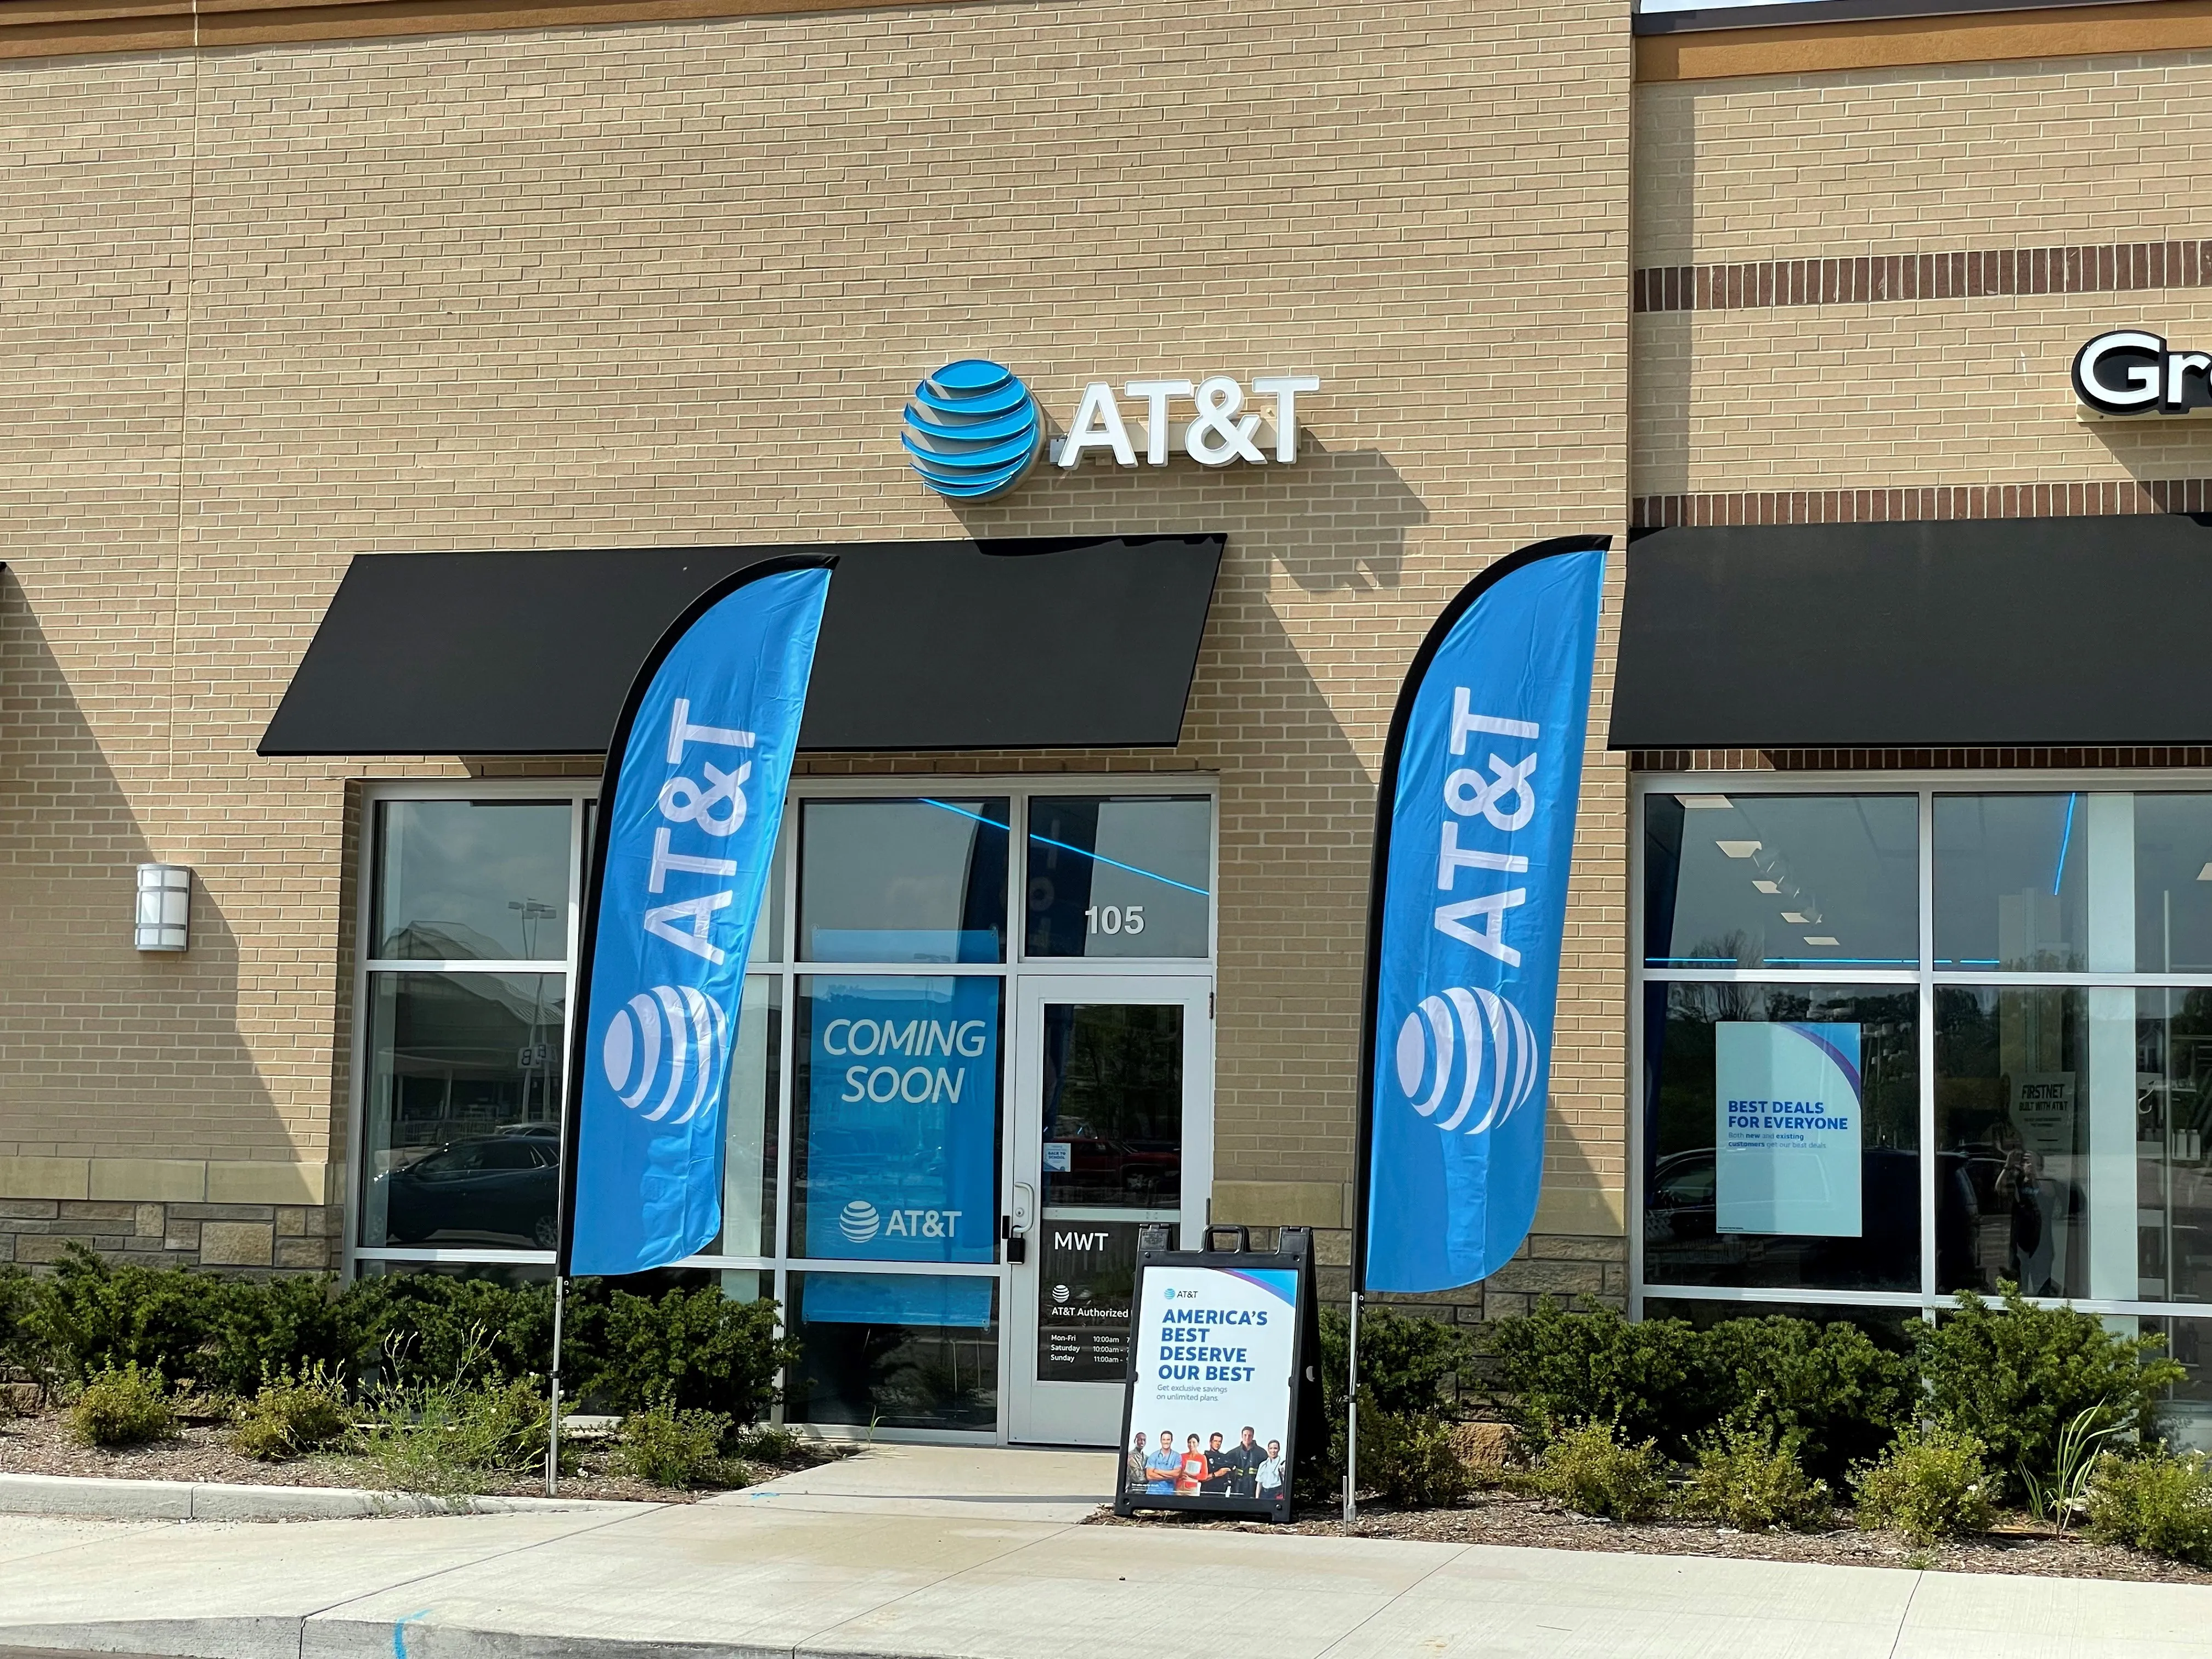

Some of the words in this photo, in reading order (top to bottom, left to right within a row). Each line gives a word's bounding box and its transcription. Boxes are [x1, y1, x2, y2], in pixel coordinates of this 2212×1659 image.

[2076, 331, 2212, 409] Gr
[1058, 375, 1320, 470] AT&T
[644, 698, 755, 966] AT&T
[1434, 686, 1539, 968] AT&T
[1085, 906, 1144, 934] 105
[823, 1019, 986, 1057] COMING
[842, 1065, 965, 1103] SOON
[2022, 1084, 2066, 1099] FIRSTNET
[1729, 1101, 1768, 1113] BEST
[1773, 1102, 1824, 1114] DEALS
[2035, 1101, 2051, 1111] WITH
[1729, 1116, 1759, 1128] FOR
[1764, 1117, 1848, 1130] EVERYONE
[885, 1210, 962, 1238] AT&T
[1054, 1232, 1109, 1251] MWT
[1051, 1307, 1075, 1316] AT&T
[1077, 1308, 1128, 1317] Authorized
[1162, 1309, 1267, 1325] AMERICA'S
[1161, 1327, 1210, 1342] BEST
[1051, 1344, 1080, 1353] Saturday
[1160, 1346, 1246, 1363] DESERVE
[1051, 1355, 1075, 1363] Sunday
[1159, 1365, 1199, 1380] OUR
[1205, 1367, 1255, 1381] BEST
[1200, 1394, 1218, 1402] plans.
[1203, 1386, 1227, 1394] savings
